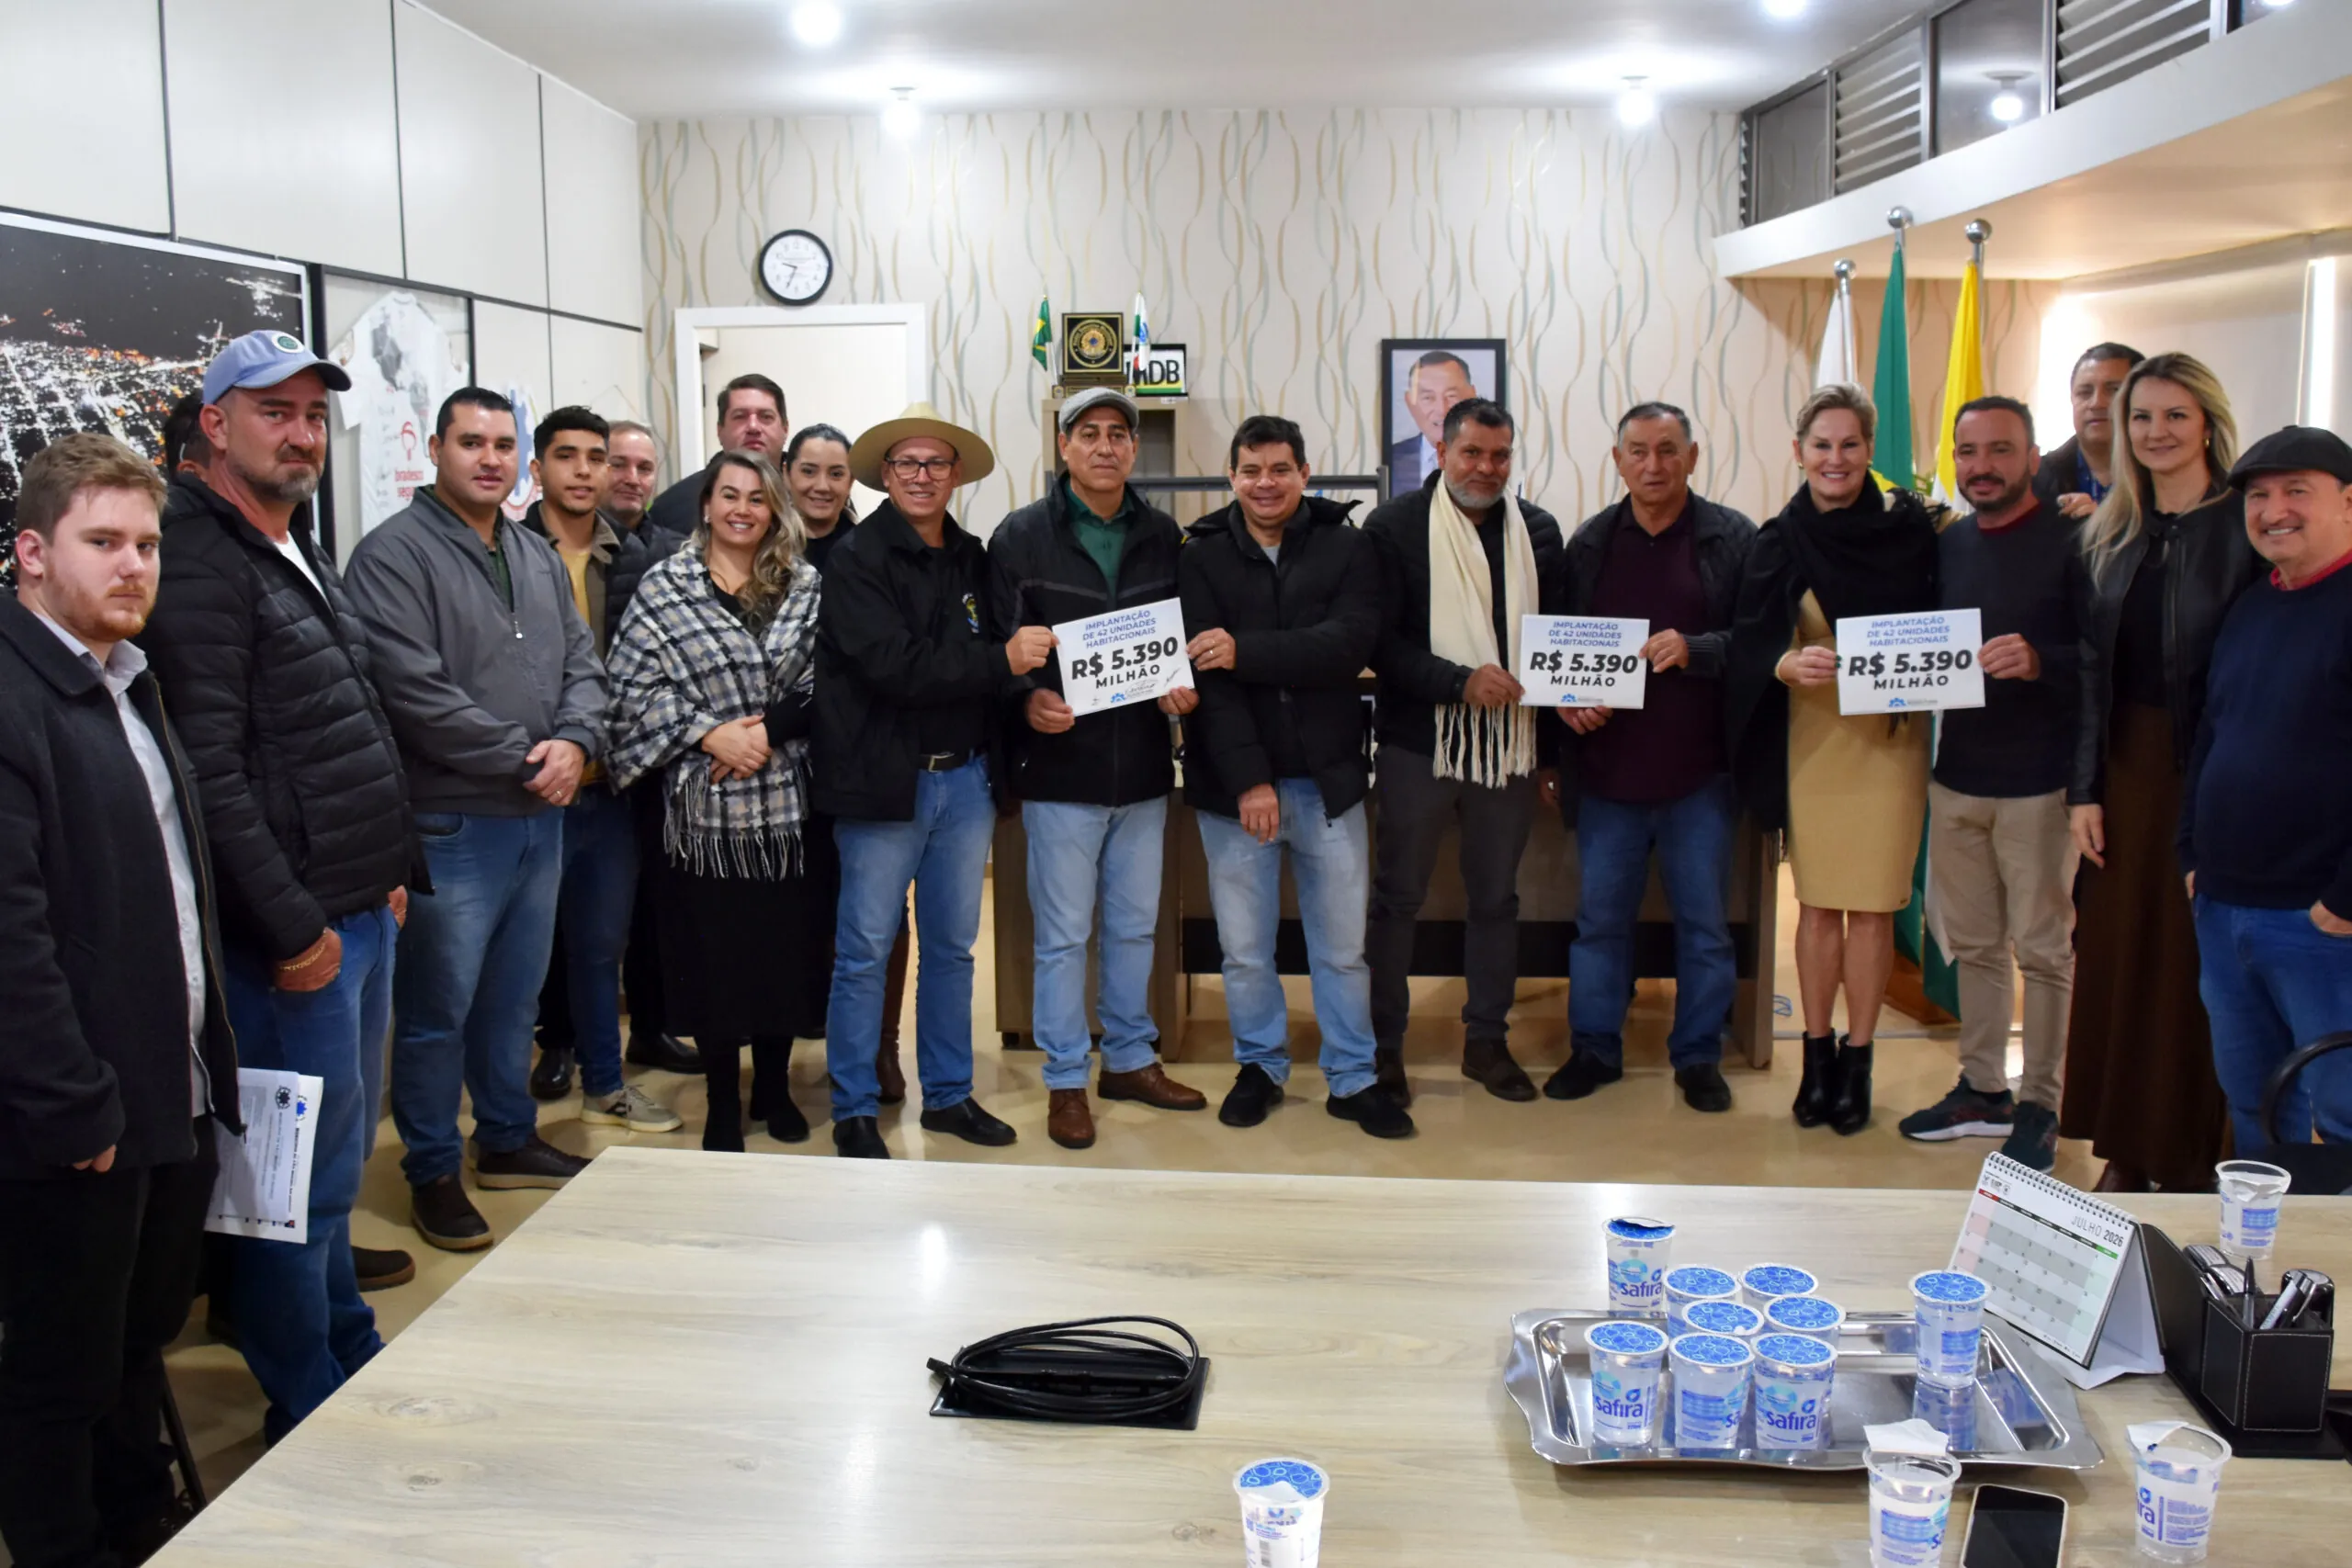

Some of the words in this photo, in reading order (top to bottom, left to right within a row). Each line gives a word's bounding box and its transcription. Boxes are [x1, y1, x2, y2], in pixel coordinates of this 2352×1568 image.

[1082, 632, 1095, 641] DE
[1097, 628, 1108, 637] 42
[1109, 617, 1157, 635] UNIDADES
[1085, 610, 1150, 631] IMPLANTAÇÃO
[1553, 621, 1618, 630] IMPLANTAÇÃO
[1871, 616, 1945, 628] IMPLANTAÇÃO
[1086, 627, 1157, 649] HABITACIONAIS
[1576, 631, 1623, 639] UNIDADES
[1867, 630, 1880, 638] DE
[1897, 626, 1951, 637] UNIDADES
[1869, 636, 1949, 648] HABITACIONAIS
[1550, 638, 1620, 647] HABITACIONAIS
[1071, 651, 1104, 680] R$
[1111, 637, 1179, 670] 5.390
[1530, 649, 1564, 674] R$
[1569, 653, 1638, 674] 5.390
[1849, 652, 1885, 677] R$
[1894, 649, 1973, 674] 5.390
[1095, 664, 1160, 689] MILHÃO
[1550, 674, 1615, 687] MILHÃO
[1873, 674, 1950, 690] MILHÃO
[2070, 1215, 2102, 1236] JULHO
[2103, 1229, 2124, 1247] 2026
[1621, 1281, 1663, 1297] safira
[1595, 1395, 1643, 1417] safira
[1767, 1410, 1817, 1430] safira
